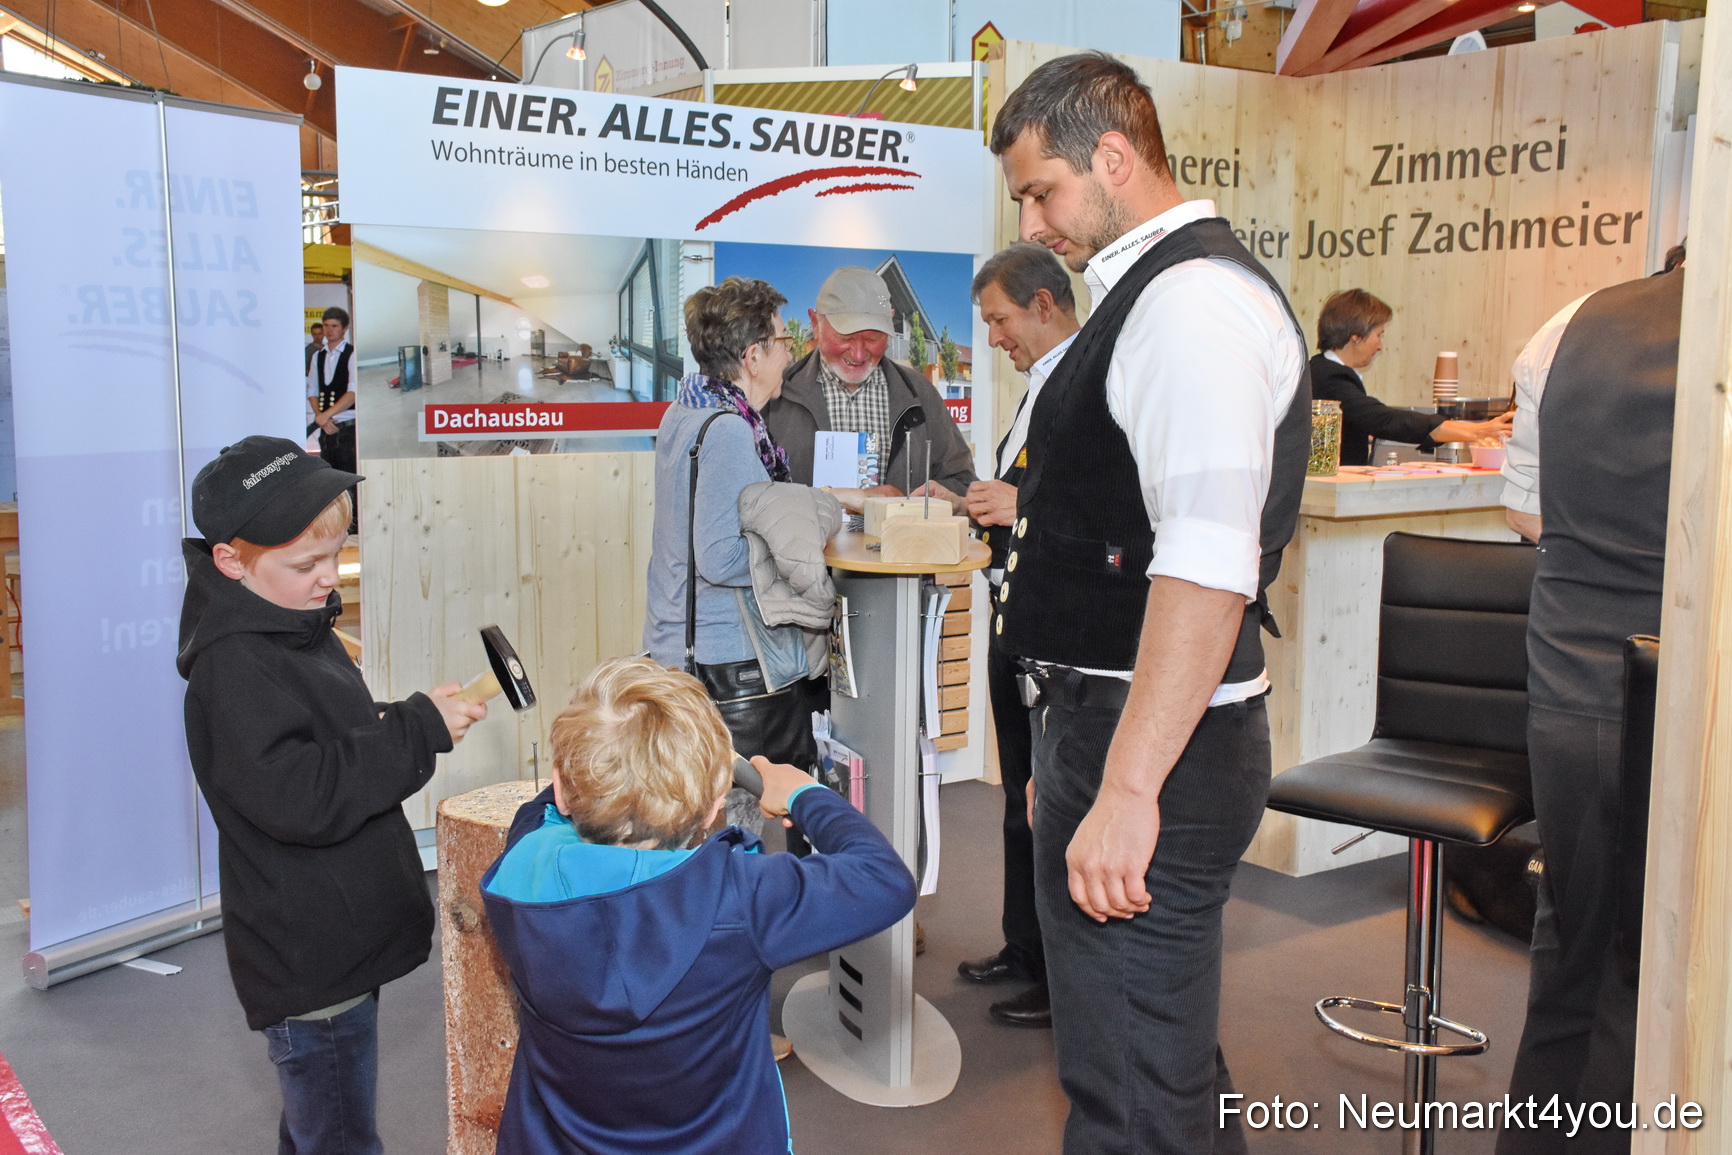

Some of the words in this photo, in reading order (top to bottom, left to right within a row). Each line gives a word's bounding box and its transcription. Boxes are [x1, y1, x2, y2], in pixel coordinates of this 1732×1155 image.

[432, 86, 587, 136] EINER.
[598, 103, 741, 149] ALLES.
[431, 139, 573, 170] Wohnträume
[580, 151, 598, 171] in
[604, 152, 670, 176] besten
[676, 159, 749, 182] Händen
[1370, 125, 1567, 187] Zimmerei
[1299, 213, 1398, 260] Josef
[1407, 201, 1644, 255] Zachmeier
[434, 408, 564, 428] Dachausbau
[946, 406, 969, 423] ng
